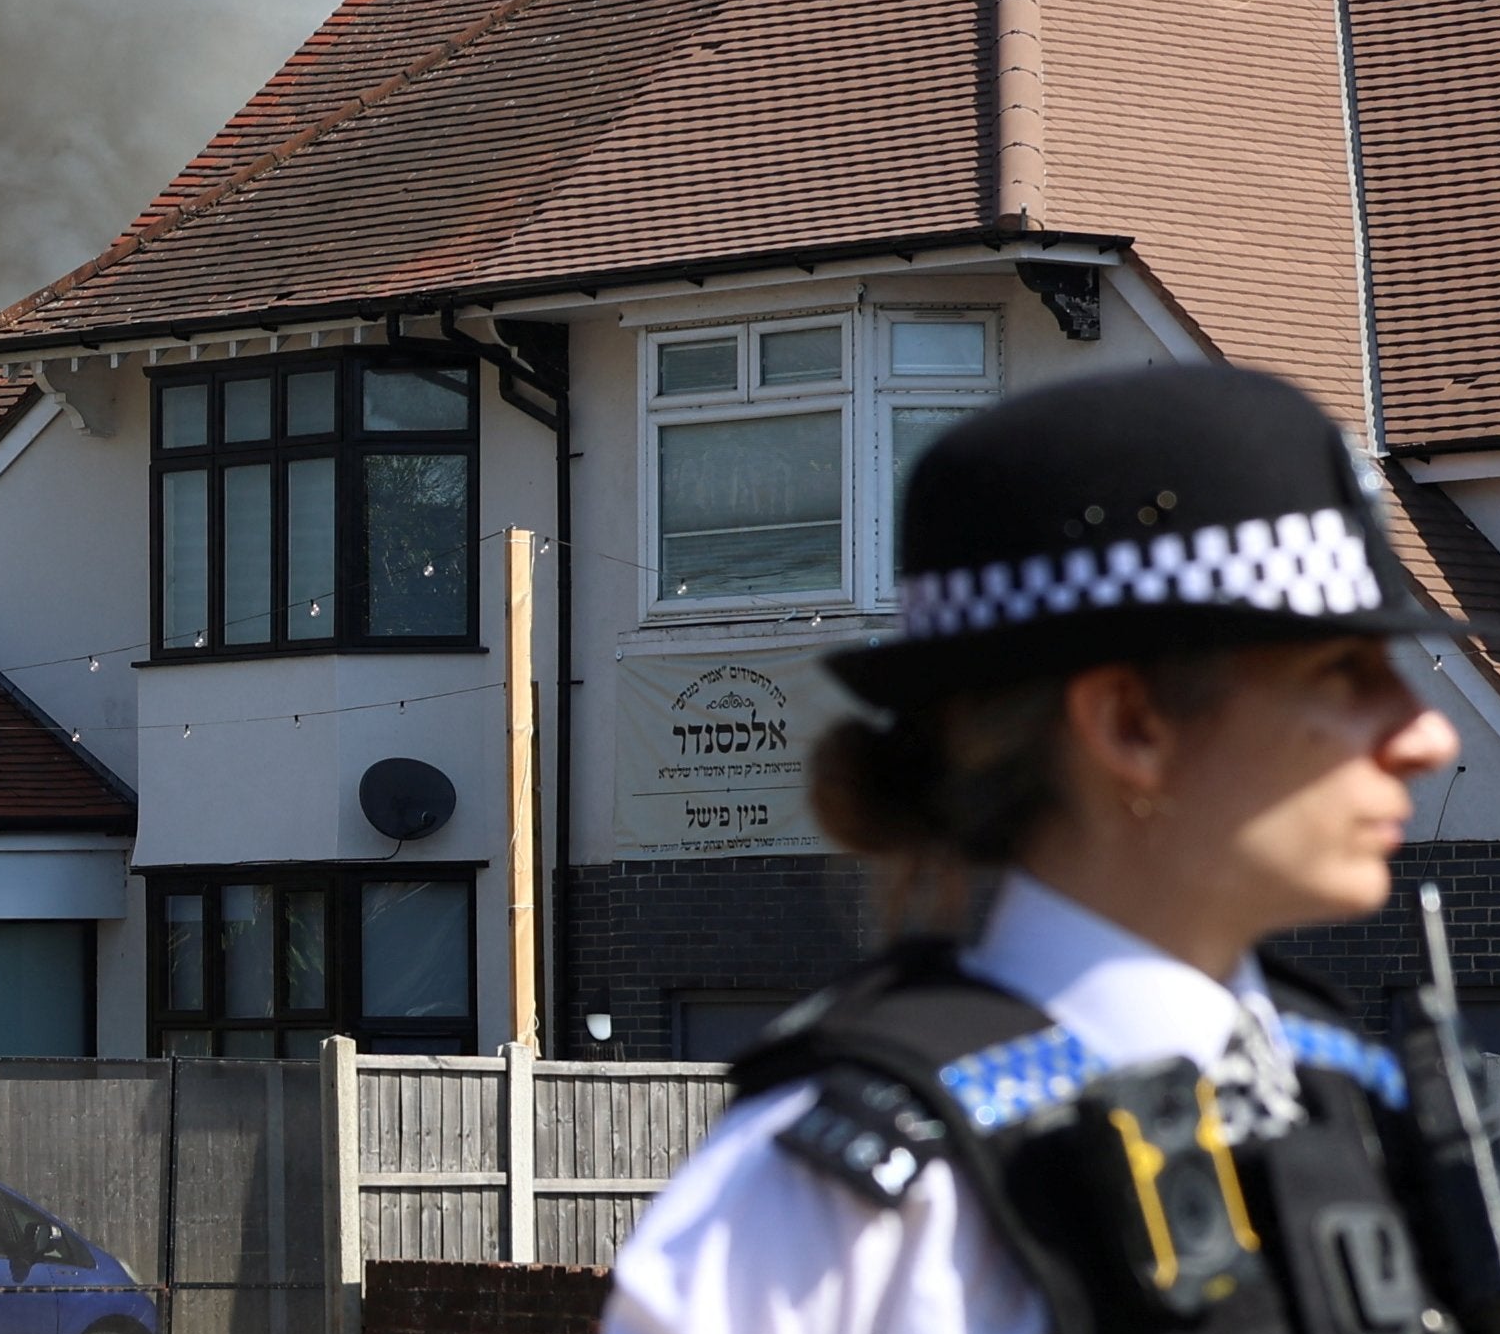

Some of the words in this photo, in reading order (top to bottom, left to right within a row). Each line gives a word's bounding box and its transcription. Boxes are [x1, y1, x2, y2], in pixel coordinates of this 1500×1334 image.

[729, 666, 772, 691] החסידים
[769, 686, 787, 708] בית
[672, 709, 787, 755] אלכסנדר
[686, 800, 730, 829] פישל
[737, 803, 768, 832] בנין
